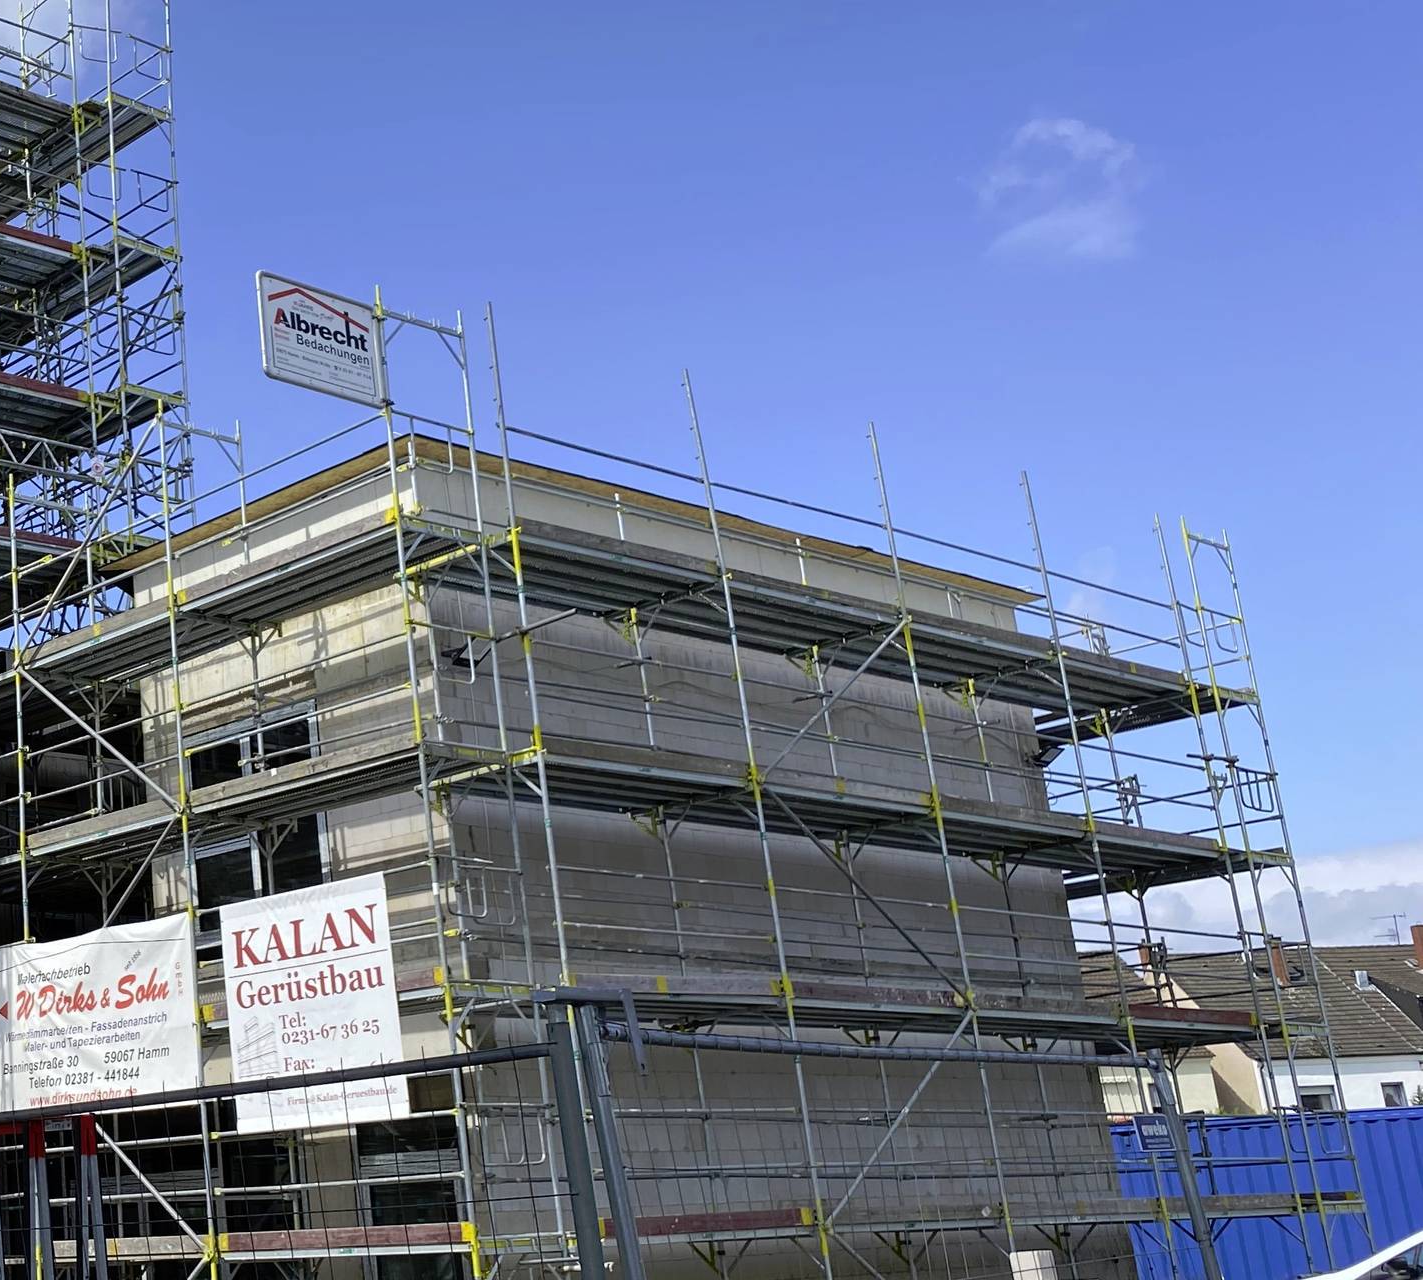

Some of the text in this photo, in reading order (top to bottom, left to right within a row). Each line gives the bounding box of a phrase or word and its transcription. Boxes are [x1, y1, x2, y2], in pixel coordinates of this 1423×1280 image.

[273, 307, 369, 352] Albrecht
[296, 333, 370, 366] Bedachungen
[231, 904, 378, 969] KALAN
[15, 967, 170, 1021] W Dirks & Sohn
[236, 964, 385, 1009] Gerüstbau
[91, 1012, 168, 1033] Fassadenanstrich
[279, 1012, 307, 1030] Tel:
[281, 1017, 381, 1045] 0231-67 36 25
[49, 1037, 67, 1050] und
[67, 1030, 142, 1049] Tapezierarbeiten
[3, 1046, 170, 1076] Banningstraße 30 59067 Hamm
[283, 1056, 315, 1073] Fax:
[29, 1075, 63, 1089] Telefon
[64, 1071, 94, 1087] 02381
[104, 1066, 141, 1082] 441844
[29, 1086, 138, 1107] www.dirksundsohn.de
